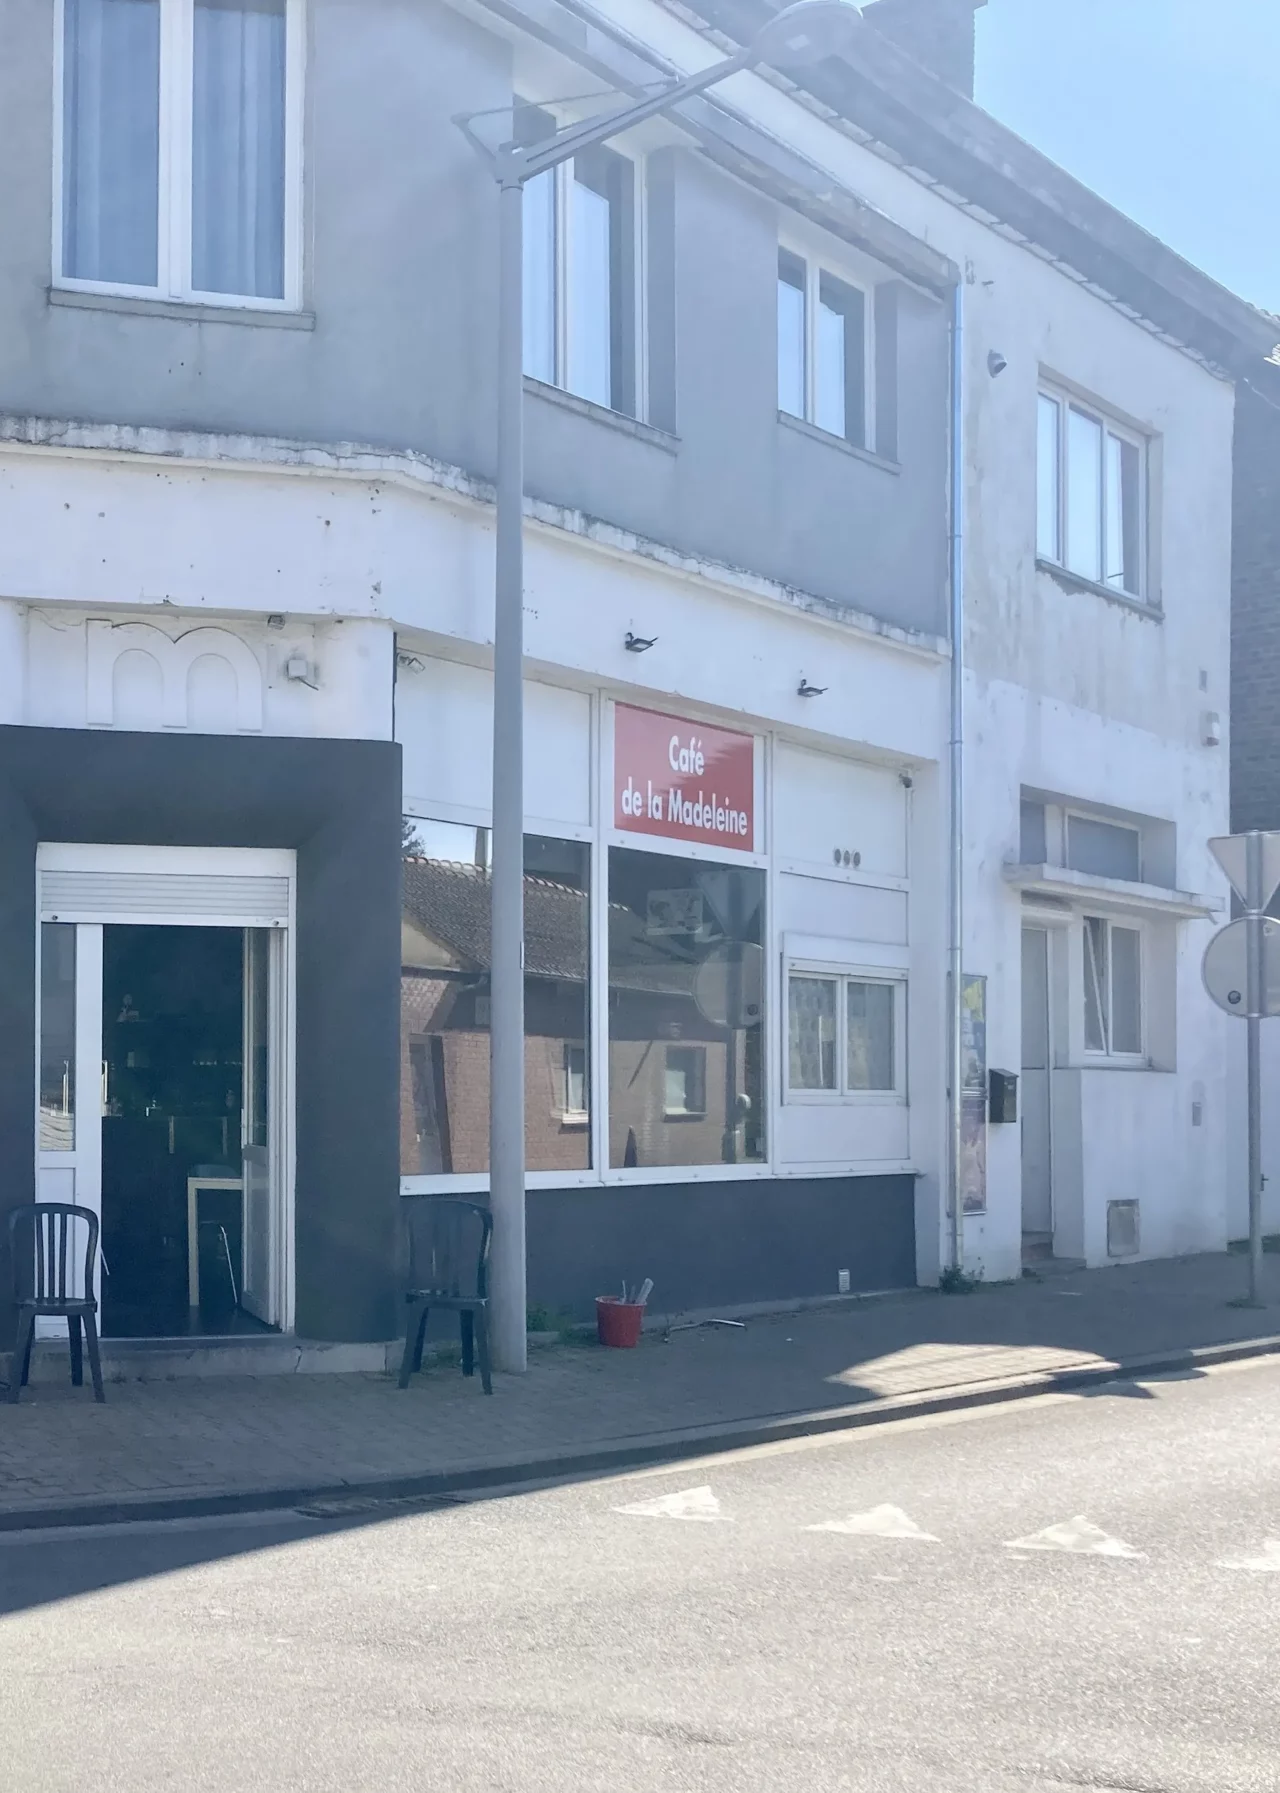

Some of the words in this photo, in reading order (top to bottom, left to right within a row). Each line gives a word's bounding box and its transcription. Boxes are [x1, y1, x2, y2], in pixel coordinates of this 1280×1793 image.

[668, 735, 705, 776] Café
[621, 776, 642, 817] de
[647, 780, 663, 821] la
[667, 787, 748, 836] Madeleine
